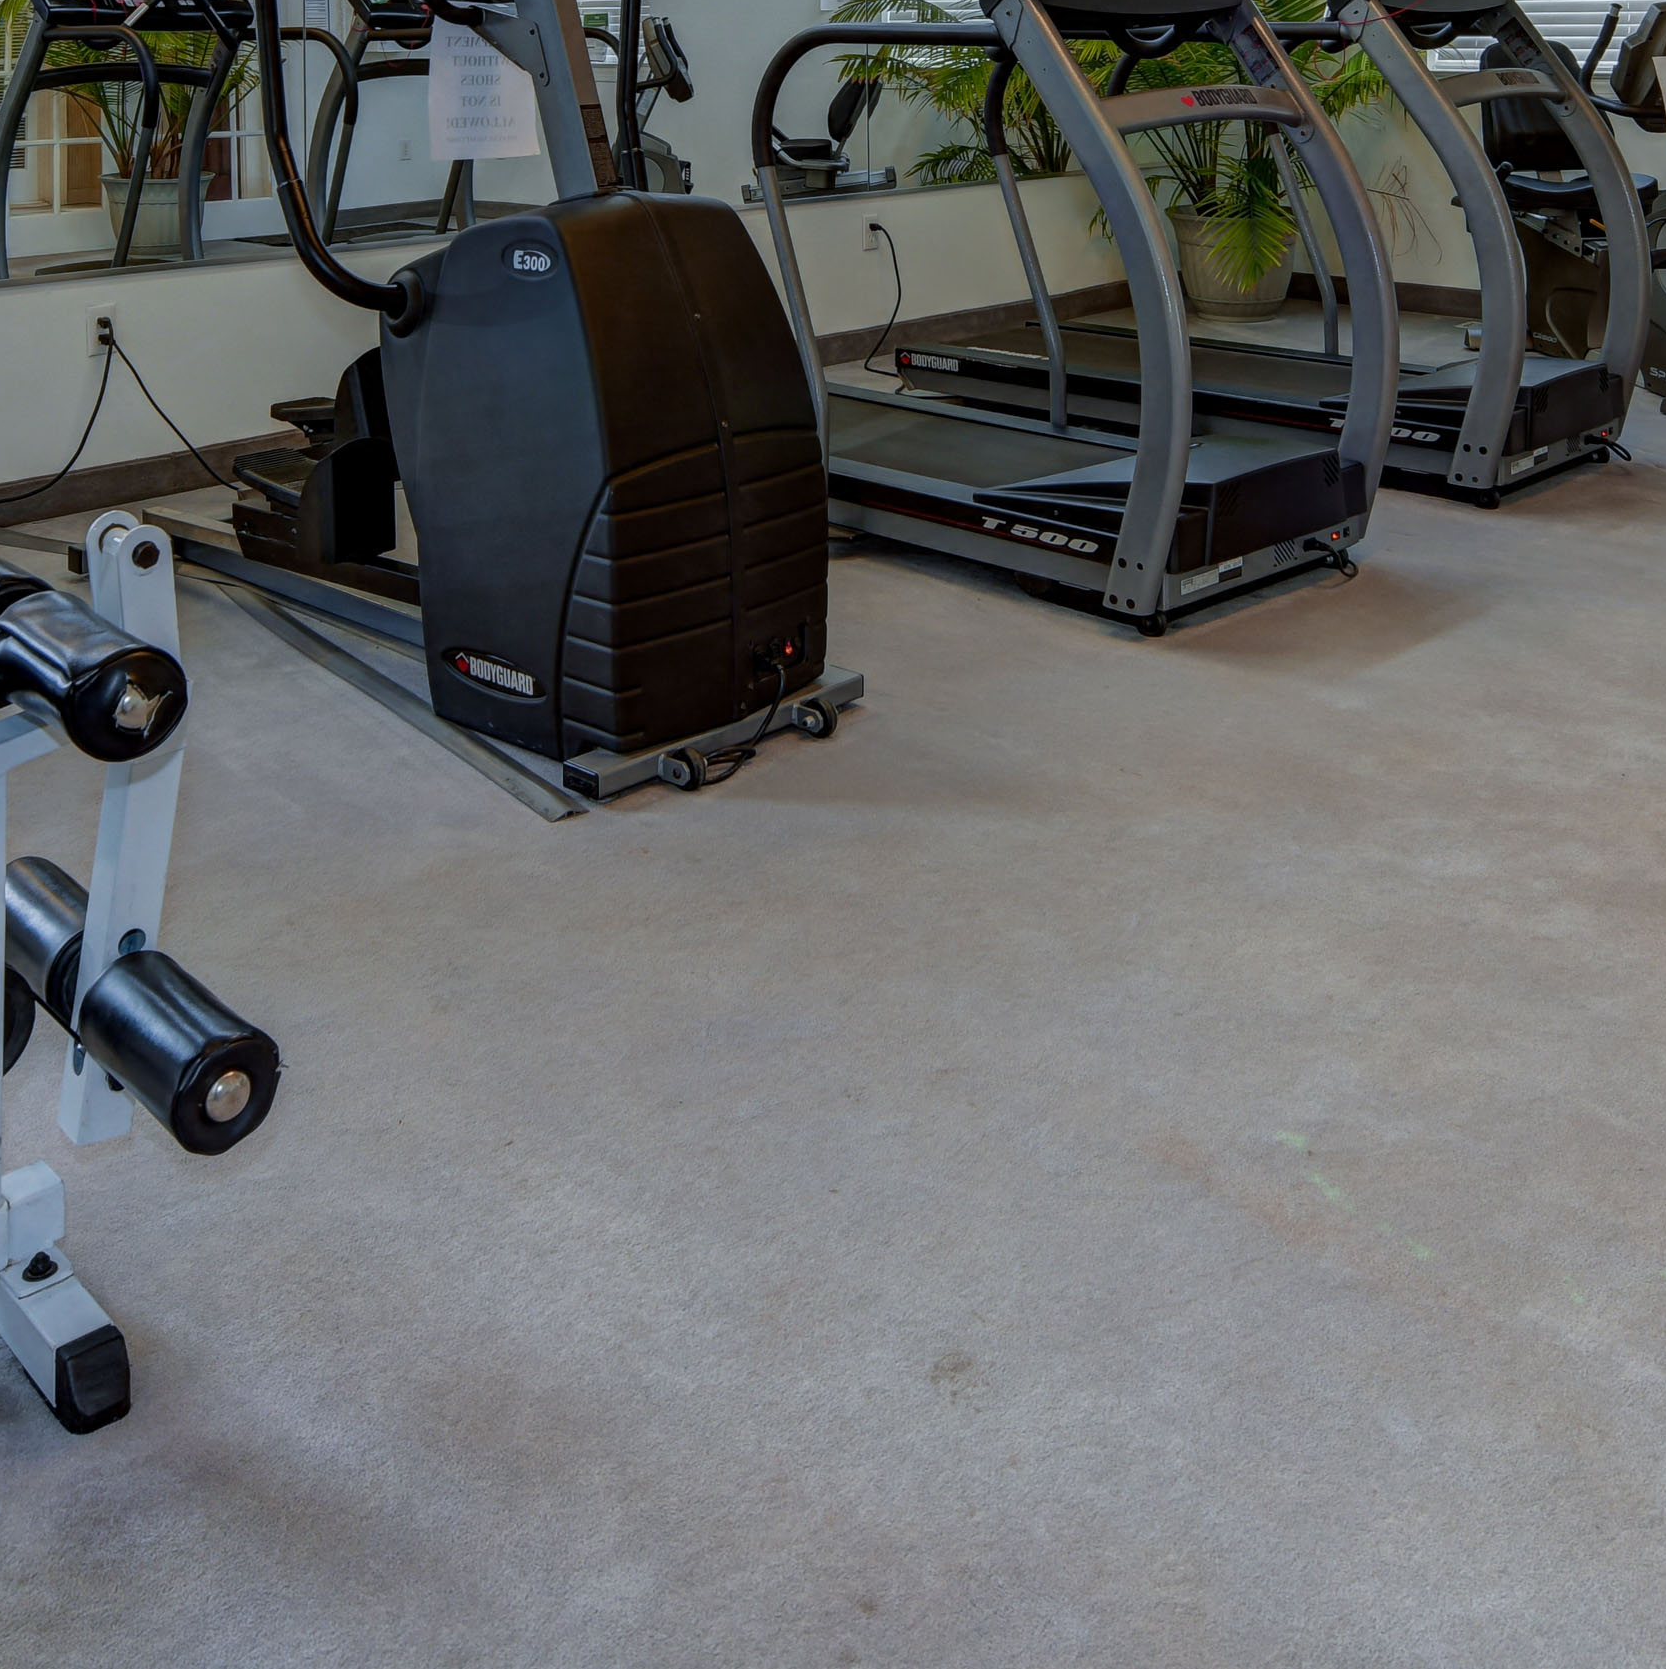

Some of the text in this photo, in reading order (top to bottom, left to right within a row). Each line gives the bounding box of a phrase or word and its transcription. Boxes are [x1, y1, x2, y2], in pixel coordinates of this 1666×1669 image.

[1191, 88, 1258, 107] BODYGUARD
[513, 249, 546, 272] E300
[911, 352, 959, 372] BODYGUARD
[981, 516, 1099, 553] T 500
[469, 656, 534, 696] BODYGUARD
